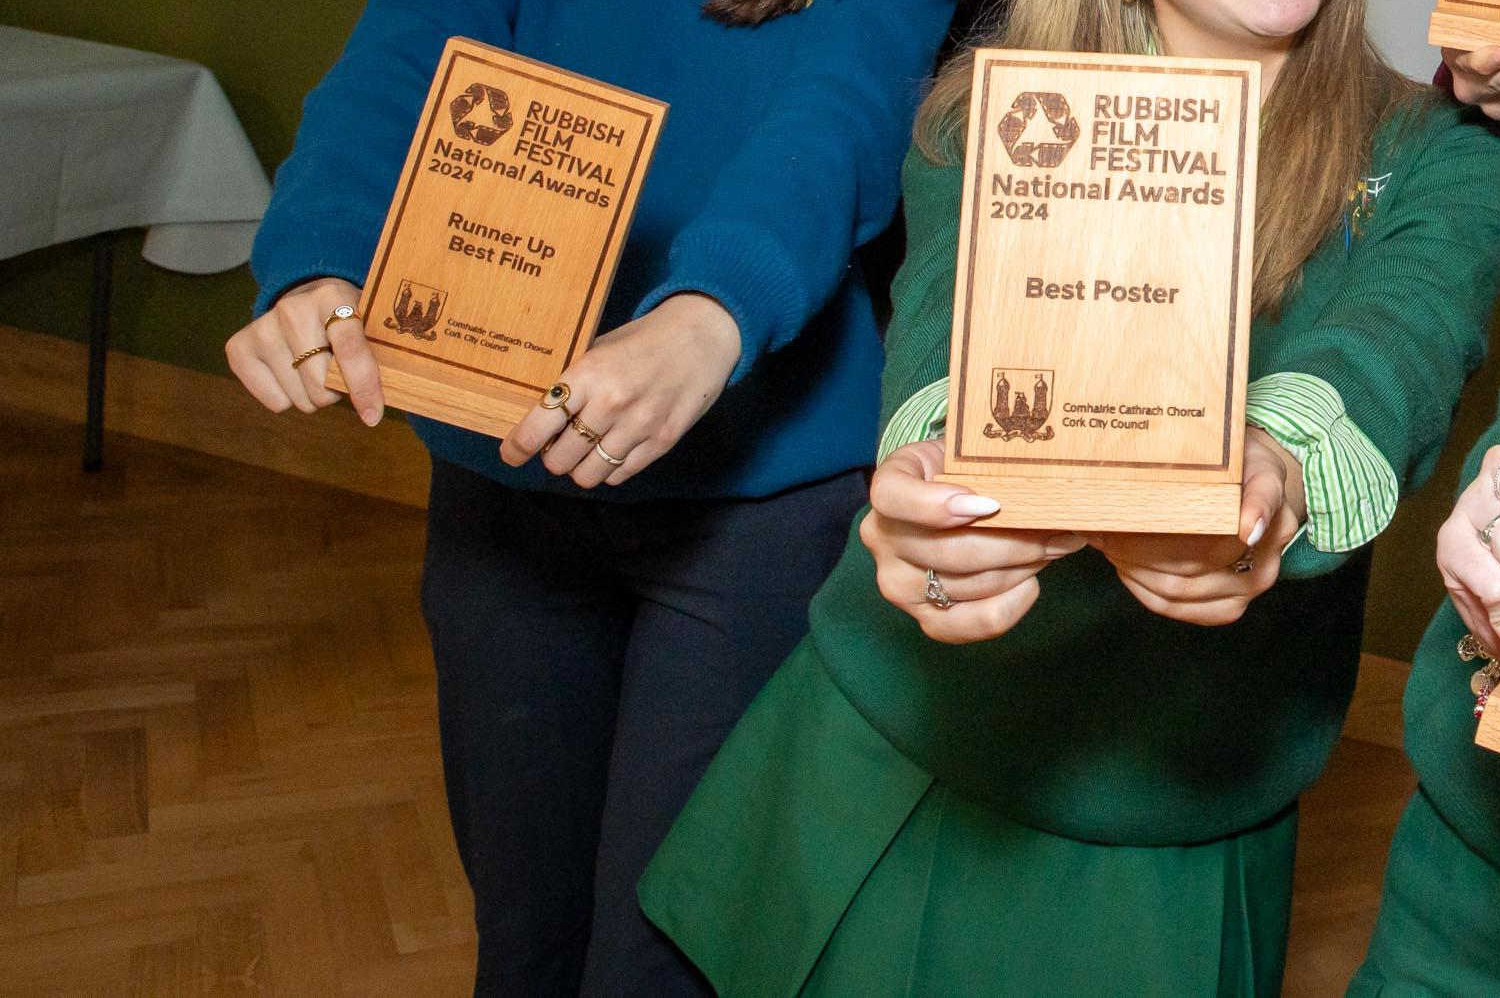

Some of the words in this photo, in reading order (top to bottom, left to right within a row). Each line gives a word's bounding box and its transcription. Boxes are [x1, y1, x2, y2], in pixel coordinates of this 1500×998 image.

[1094, 94, 1220, 124] RUBBISH
[520, 123, 573, 151] FILM
[526, 101, 625, 146] RUBBISH
[1092, 121, 1160, 147] FILM
[428, 159, 474, 184] 2024
[433, 138, 526, 182] National
[528, 170, 611, 208] Awards
[513, 142, 616, 187] FESTIVAL
[1090, 147, 1226, 176] FESTIVAL
[992, 173, 1110, 201] National
[1118, 178, 1225, 205] Awards
[990, 201, 1049, 221] 2024
[448, 212, 522, 246] Runner
[527, 236, 555, 261] Up
[448, 237, 495, 264] Best
[499, 252, 542, 277] Film
[1026, 277, 1085, 301] Best
[1093, 279, 1179, 304] Poster
[444, 328, 462, 339] Cork
[464, 334, 478, 344] City
[480, 339, 510, 352] Council
[488, 330, 522, 346] Cathrach
[1063, 403, 1116, 414] Comhairle
[1118, 405, 1163, 416] Cathrach
[1062, 418, 1086, 428] Cork
[1088, 418, 1108, 429] City
[1111, 420, 1149, 430] Council
